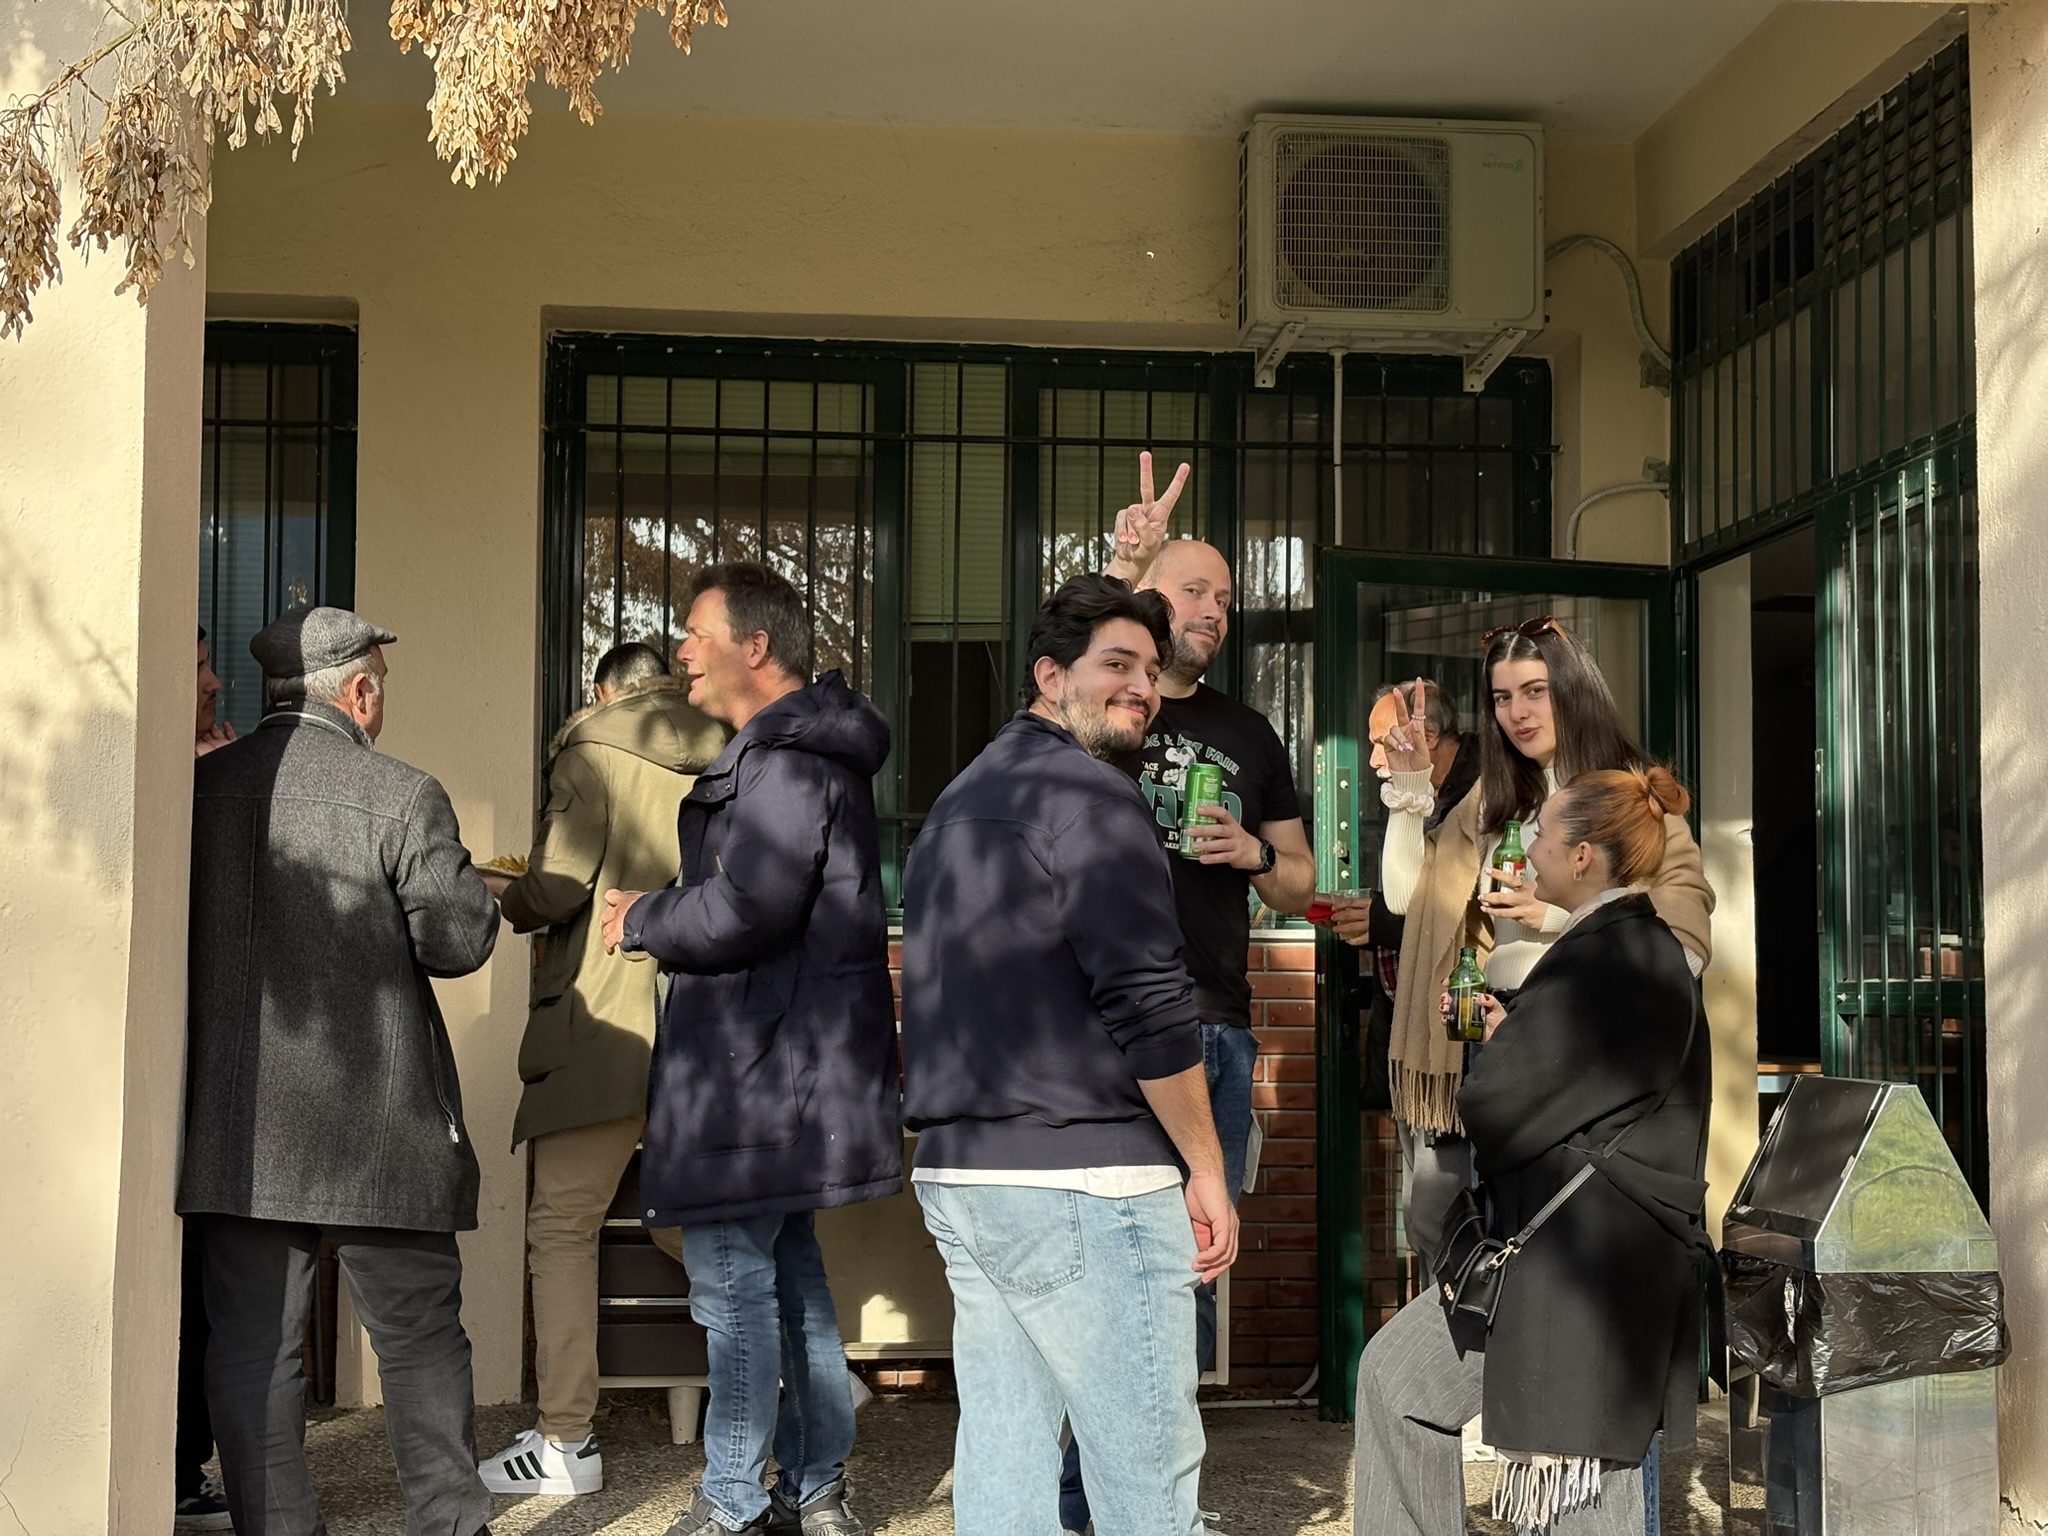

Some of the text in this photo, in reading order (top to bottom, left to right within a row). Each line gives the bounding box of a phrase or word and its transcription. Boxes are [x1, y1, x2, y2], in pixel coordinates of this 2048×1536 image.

[1163, 733, 1175, 747] &
[1204, 746, 1240, 776] FAIR
[1141, 760, 1159, 772] ACE
[1167, 830, 1180, 841] EV
